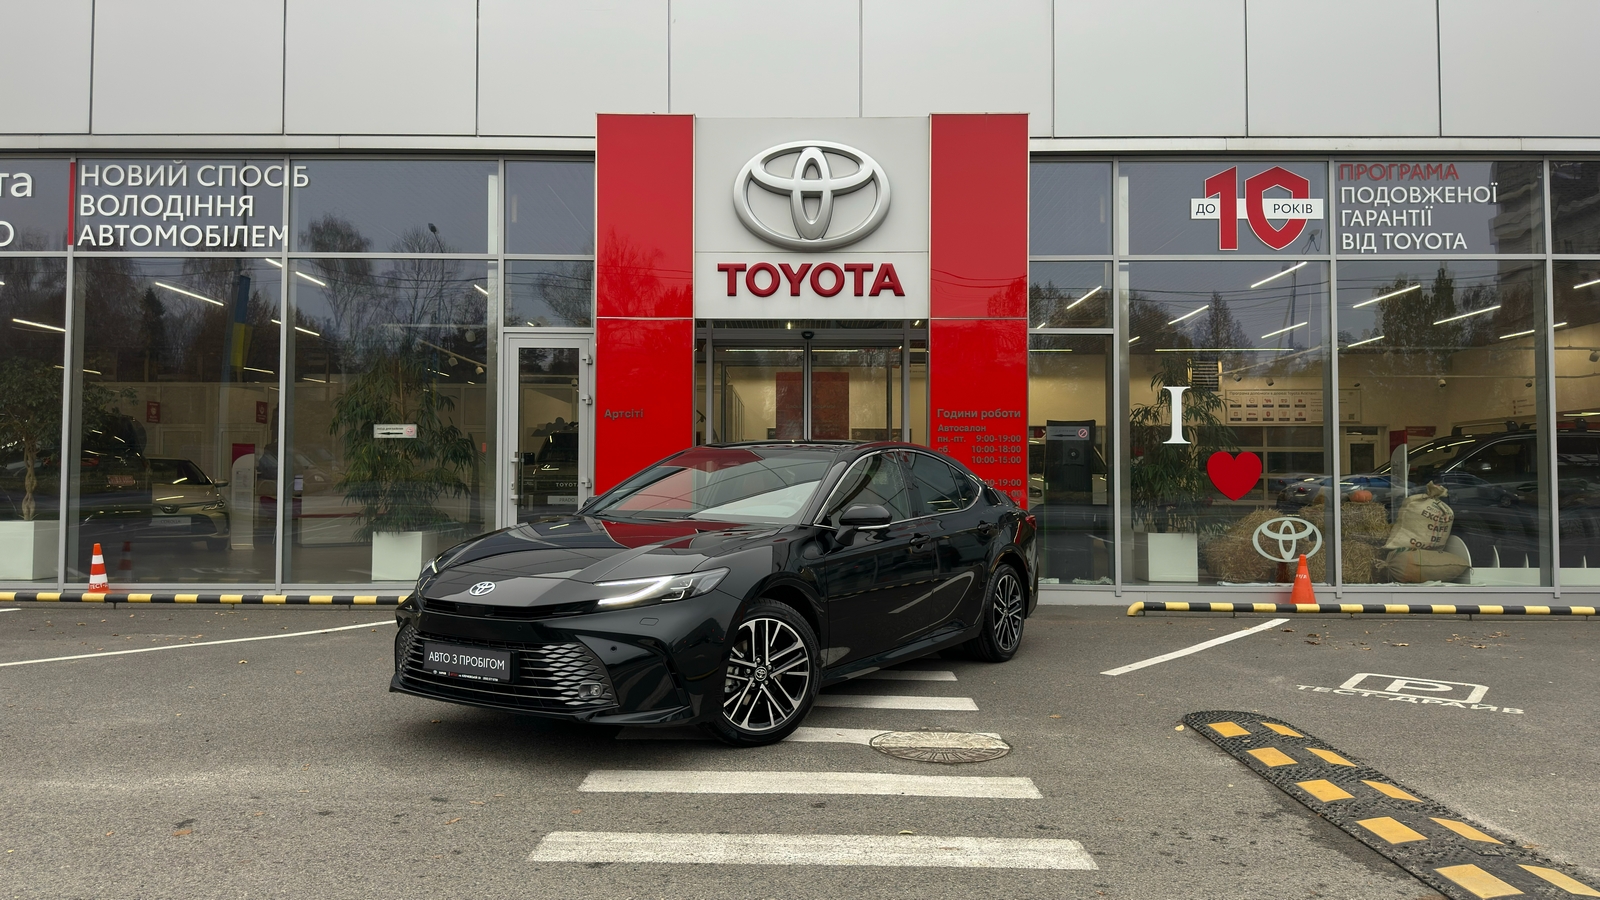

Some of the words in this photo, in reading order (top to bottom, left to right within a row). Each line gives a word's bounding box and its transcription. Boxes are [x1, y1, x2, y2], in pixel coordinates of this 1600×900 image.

[81, 160, 187, 187] НОВИЙ
[197, 165, 309, 187] СПОСІБ
[1339, 163, 1459, 181] ПРОГРАМА
[1341, 182, 1498, 207] ПОДОВЖЕНОЇ
[80, 194, 254, 221] ВОЛОДІННЯ
[1196, 204, 1216, 216] ДО
[1204, 165, 1310, 251] 10
[1273, 203, 1313, 214] РОКІВ
[1341, 205, 1433, 227] ГАРАНТІЇ
[77, 224, 288, 247] АВТОМОБІЛЕМ
[1342, 233, 1377, 253] ВІД
[1382, 232, 1468, 250] TOYOTA
[717, 262, 905, 298] TOYOTA
[604, 408, 644, 420] Артсіті
[937, 409, 978, 419] Години
[981, 409, 1021, 420] роботи
[1162, 386, 1192, 444] I
[937, 424, 987, 432] Автосалон
[971, 445, 1021, 453] 10:00-18:00
[976, 435, 1021, 443] 9:00-19:00
[971, 456, 1021, 464] 10:00-15:00
[428, 651, 451, 663] АВТО
[452, 653, 458, 665] З
[459, 654, 505, 671] ПРОБІГОМ
[1384, 678, 1453, 692] P
[1296, 684, 1525, 715] ТЕСТ-ДРАЙВ
